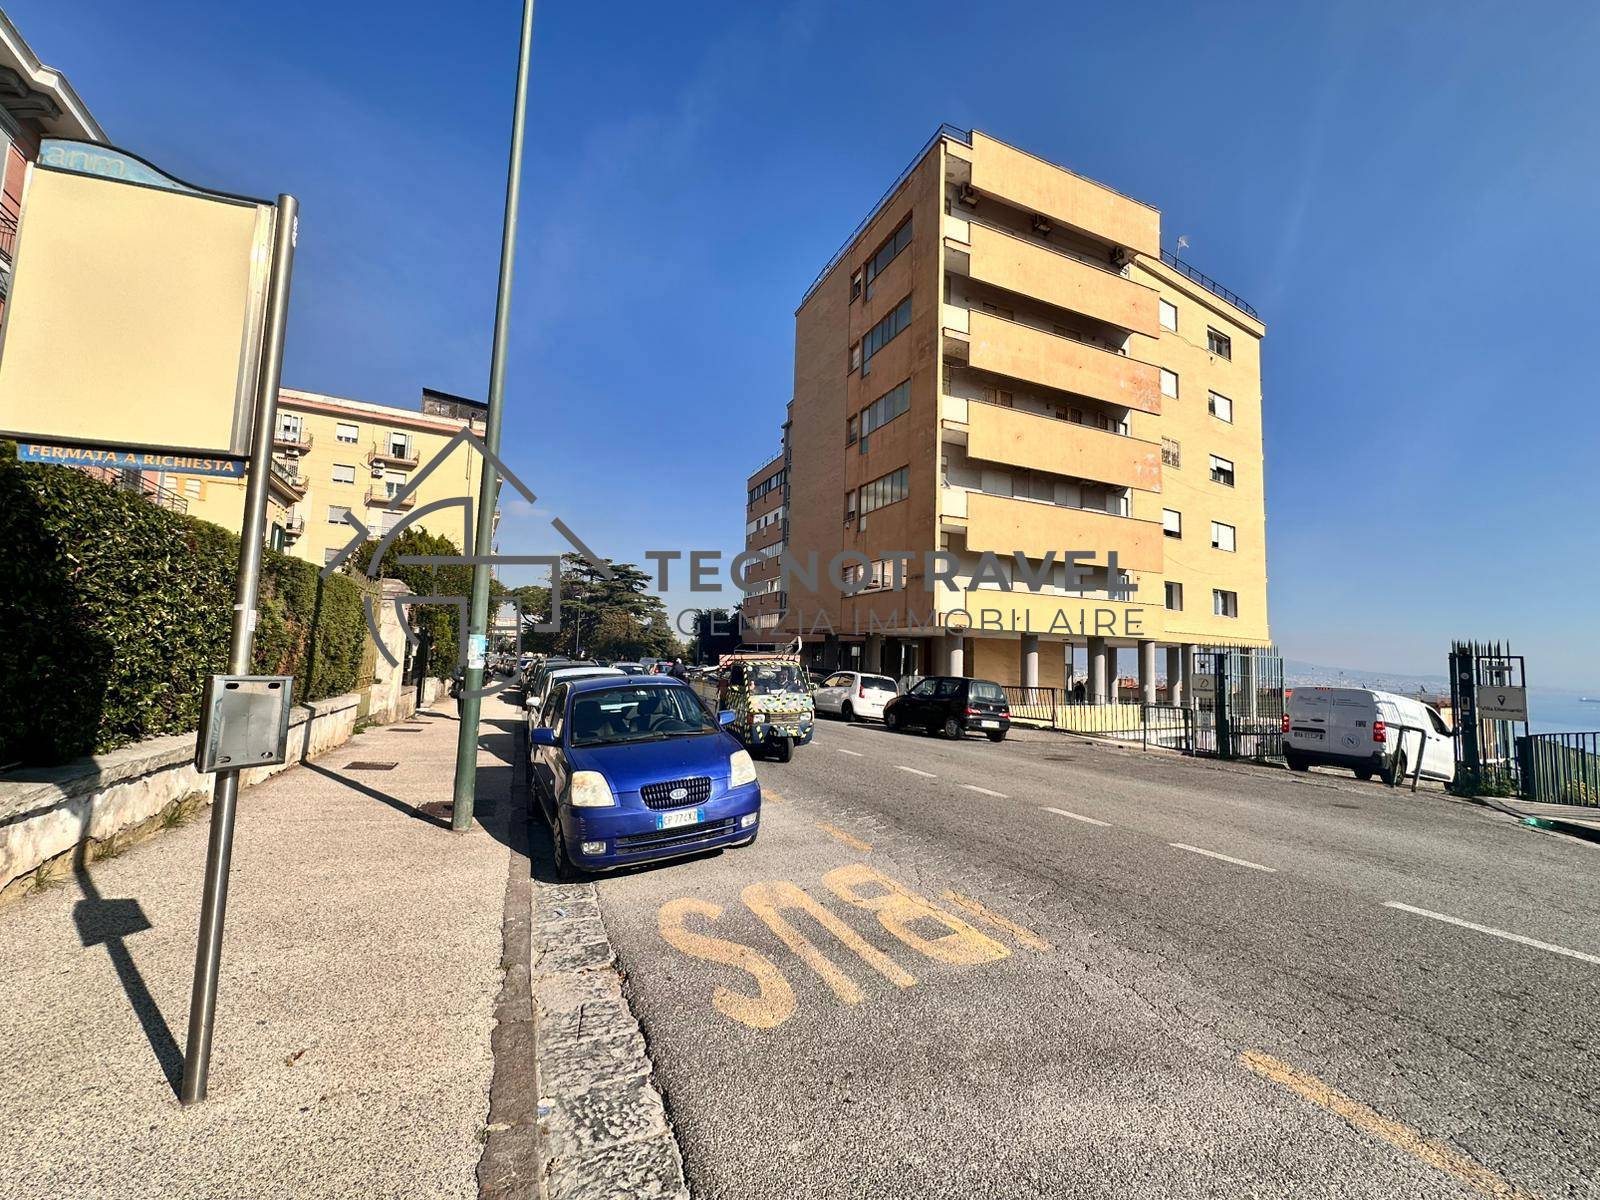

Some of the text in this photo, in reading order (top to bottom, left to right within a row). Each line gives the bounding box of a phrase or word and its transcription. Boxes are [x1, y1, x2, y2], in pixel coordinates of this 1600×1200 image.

[29, 445, 234, 471] FERMATA A RICHIESTA
[658, 863, 1012, 1029] BUS
